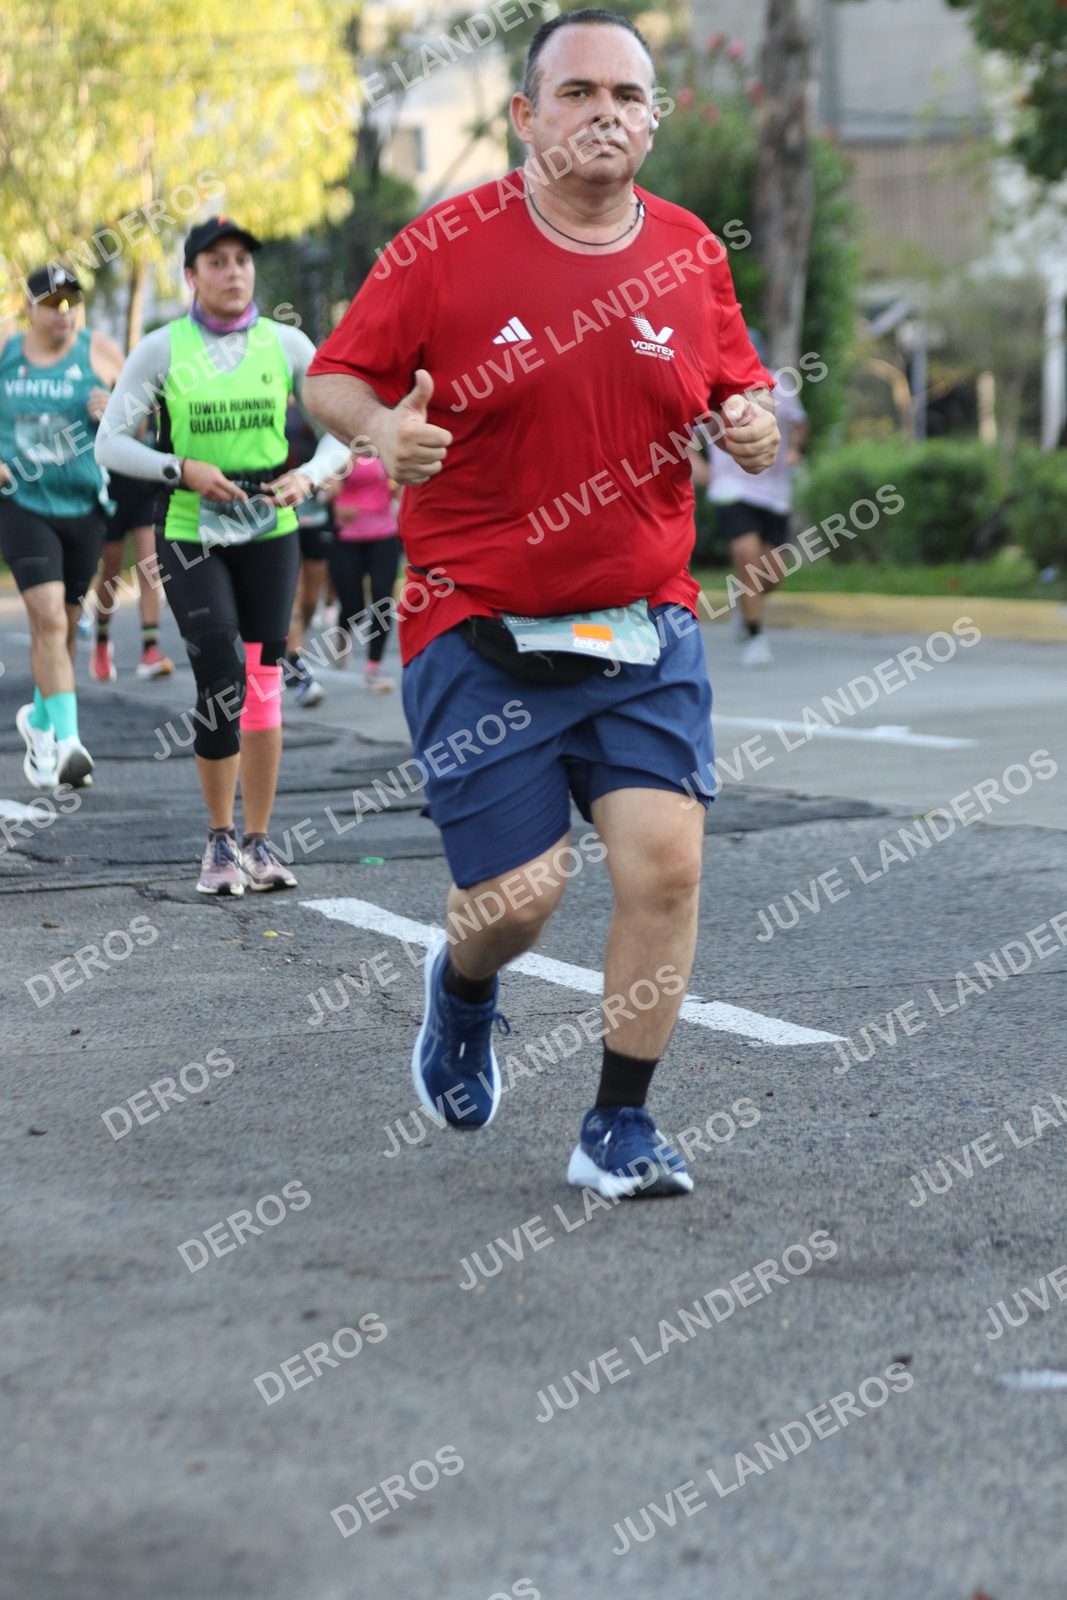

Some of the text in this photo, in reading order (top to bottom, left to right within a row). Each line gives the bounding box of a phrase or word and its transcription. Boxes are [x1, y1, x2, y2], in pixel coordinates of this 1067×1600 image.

[631, 340, 675, 358] VORTEX
[5, 378, 74, 399] VENTUS
[188, 400, 227, 416] TOWER
[190, 412, 274, 434] GUADALAJARA
